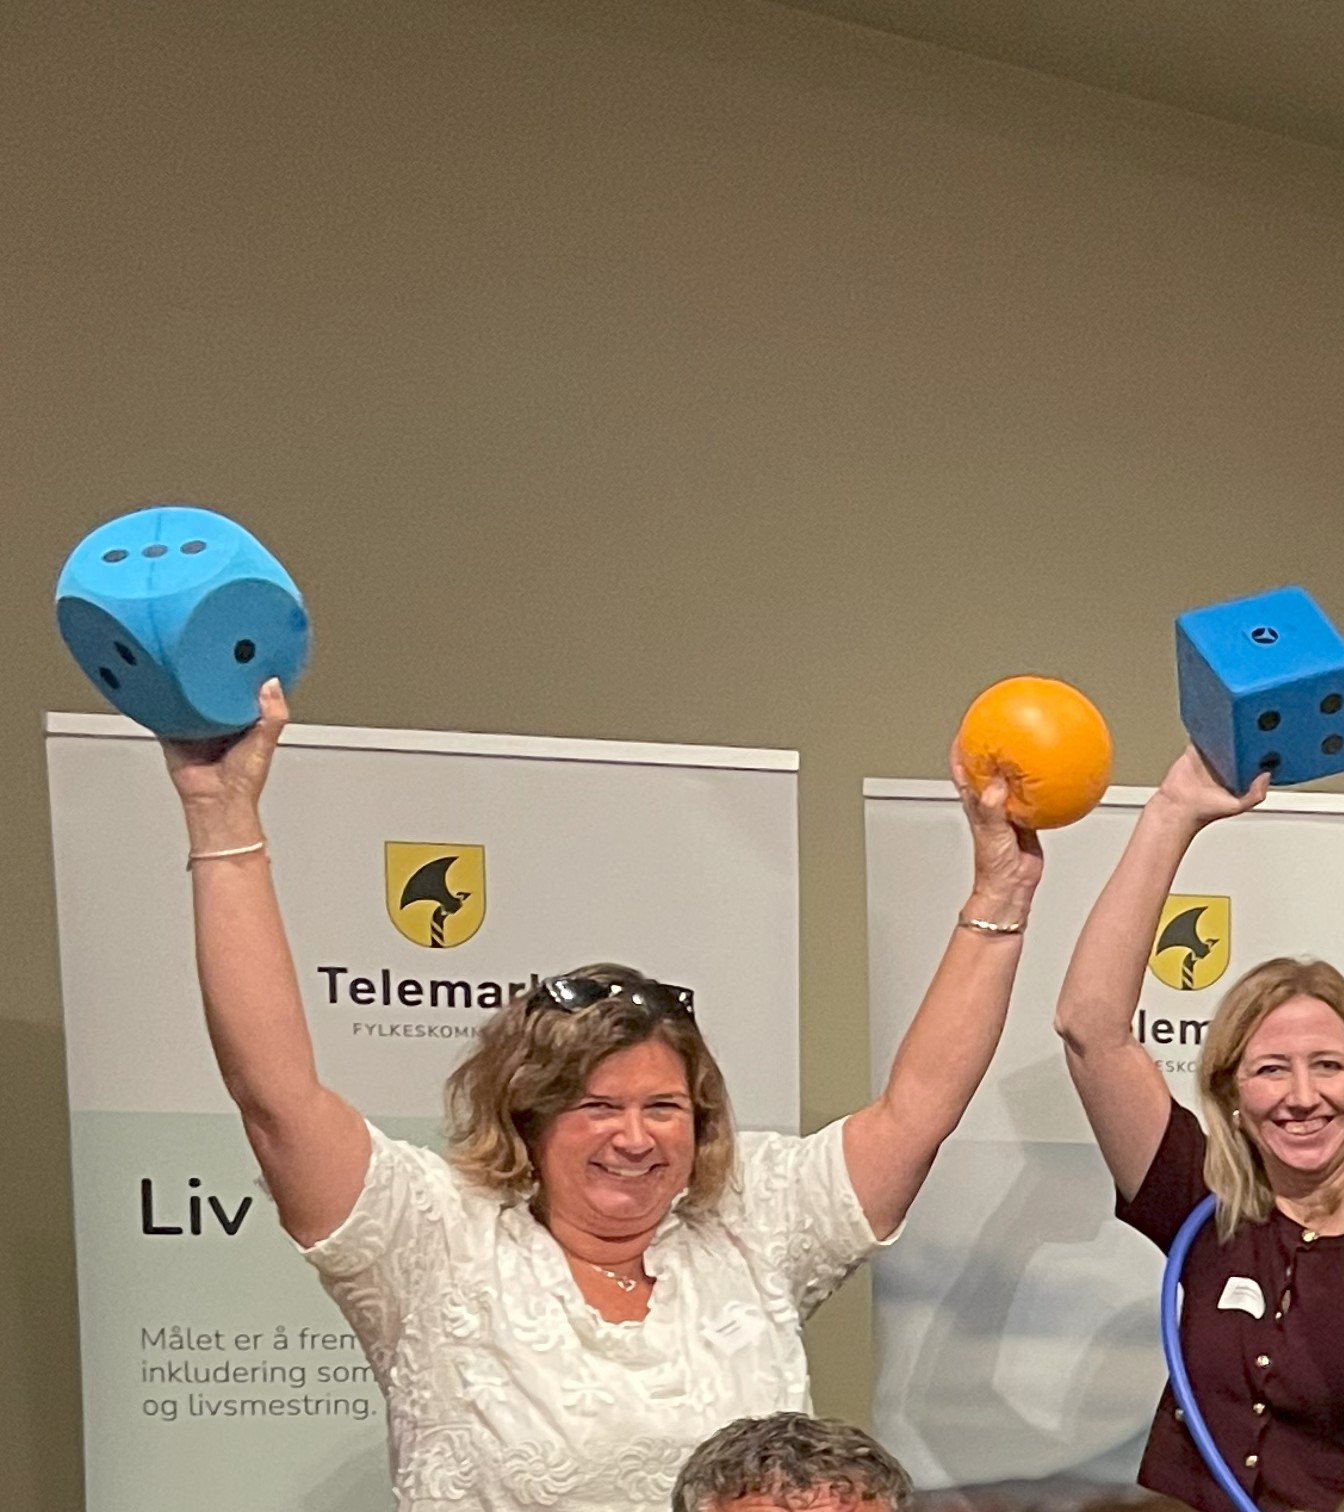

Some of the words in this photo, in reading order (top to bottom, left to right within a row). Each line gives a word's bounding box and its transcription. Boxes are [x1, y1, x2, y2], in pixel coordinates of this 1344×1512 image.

[317, 966, 540, 1009] Telemar
[141, 1177, 253, 1236] Liv
[141, 1325, 226, 1351] Målet
[234, 1332, 263, 1351] er
[272, 1325, 289, 1350] å
[141, 1360, 306, 1389] inkludering
[142, 1399, 178, 1421] og
[188, 1393, 378, 1420] livsmestring.
